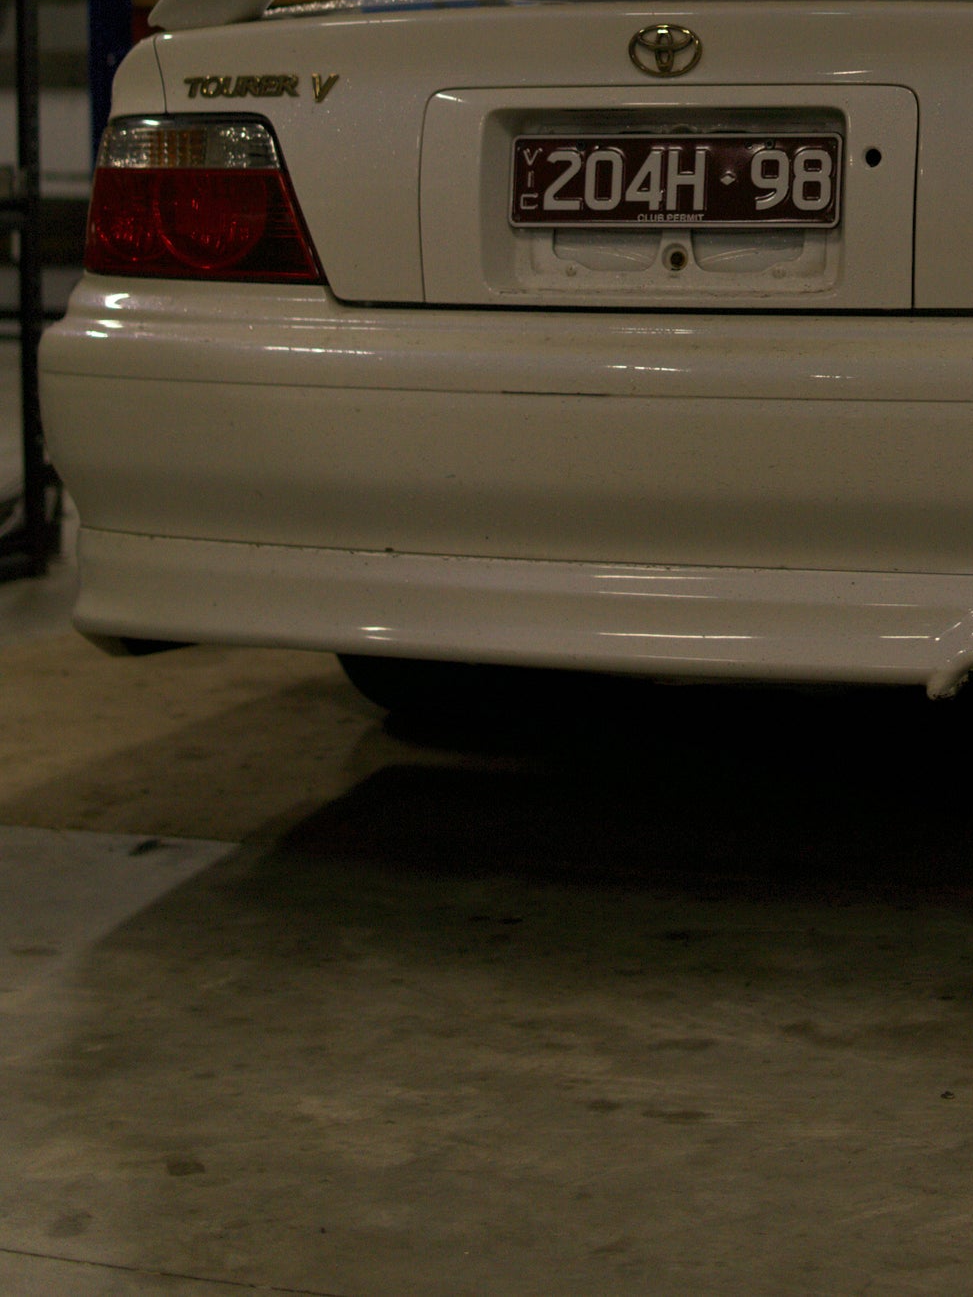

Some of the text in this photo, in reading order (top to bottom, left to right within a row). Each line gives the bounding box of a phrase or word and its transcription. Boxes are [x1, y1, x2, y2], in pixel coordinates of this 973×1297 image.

[184, 72, 340, 103] TOURER V
[519, 148, 543, 210] VIC
[543, 149, 833, 211] 204H 98
[636, 213, 705, 223] CLUB PERMIT
